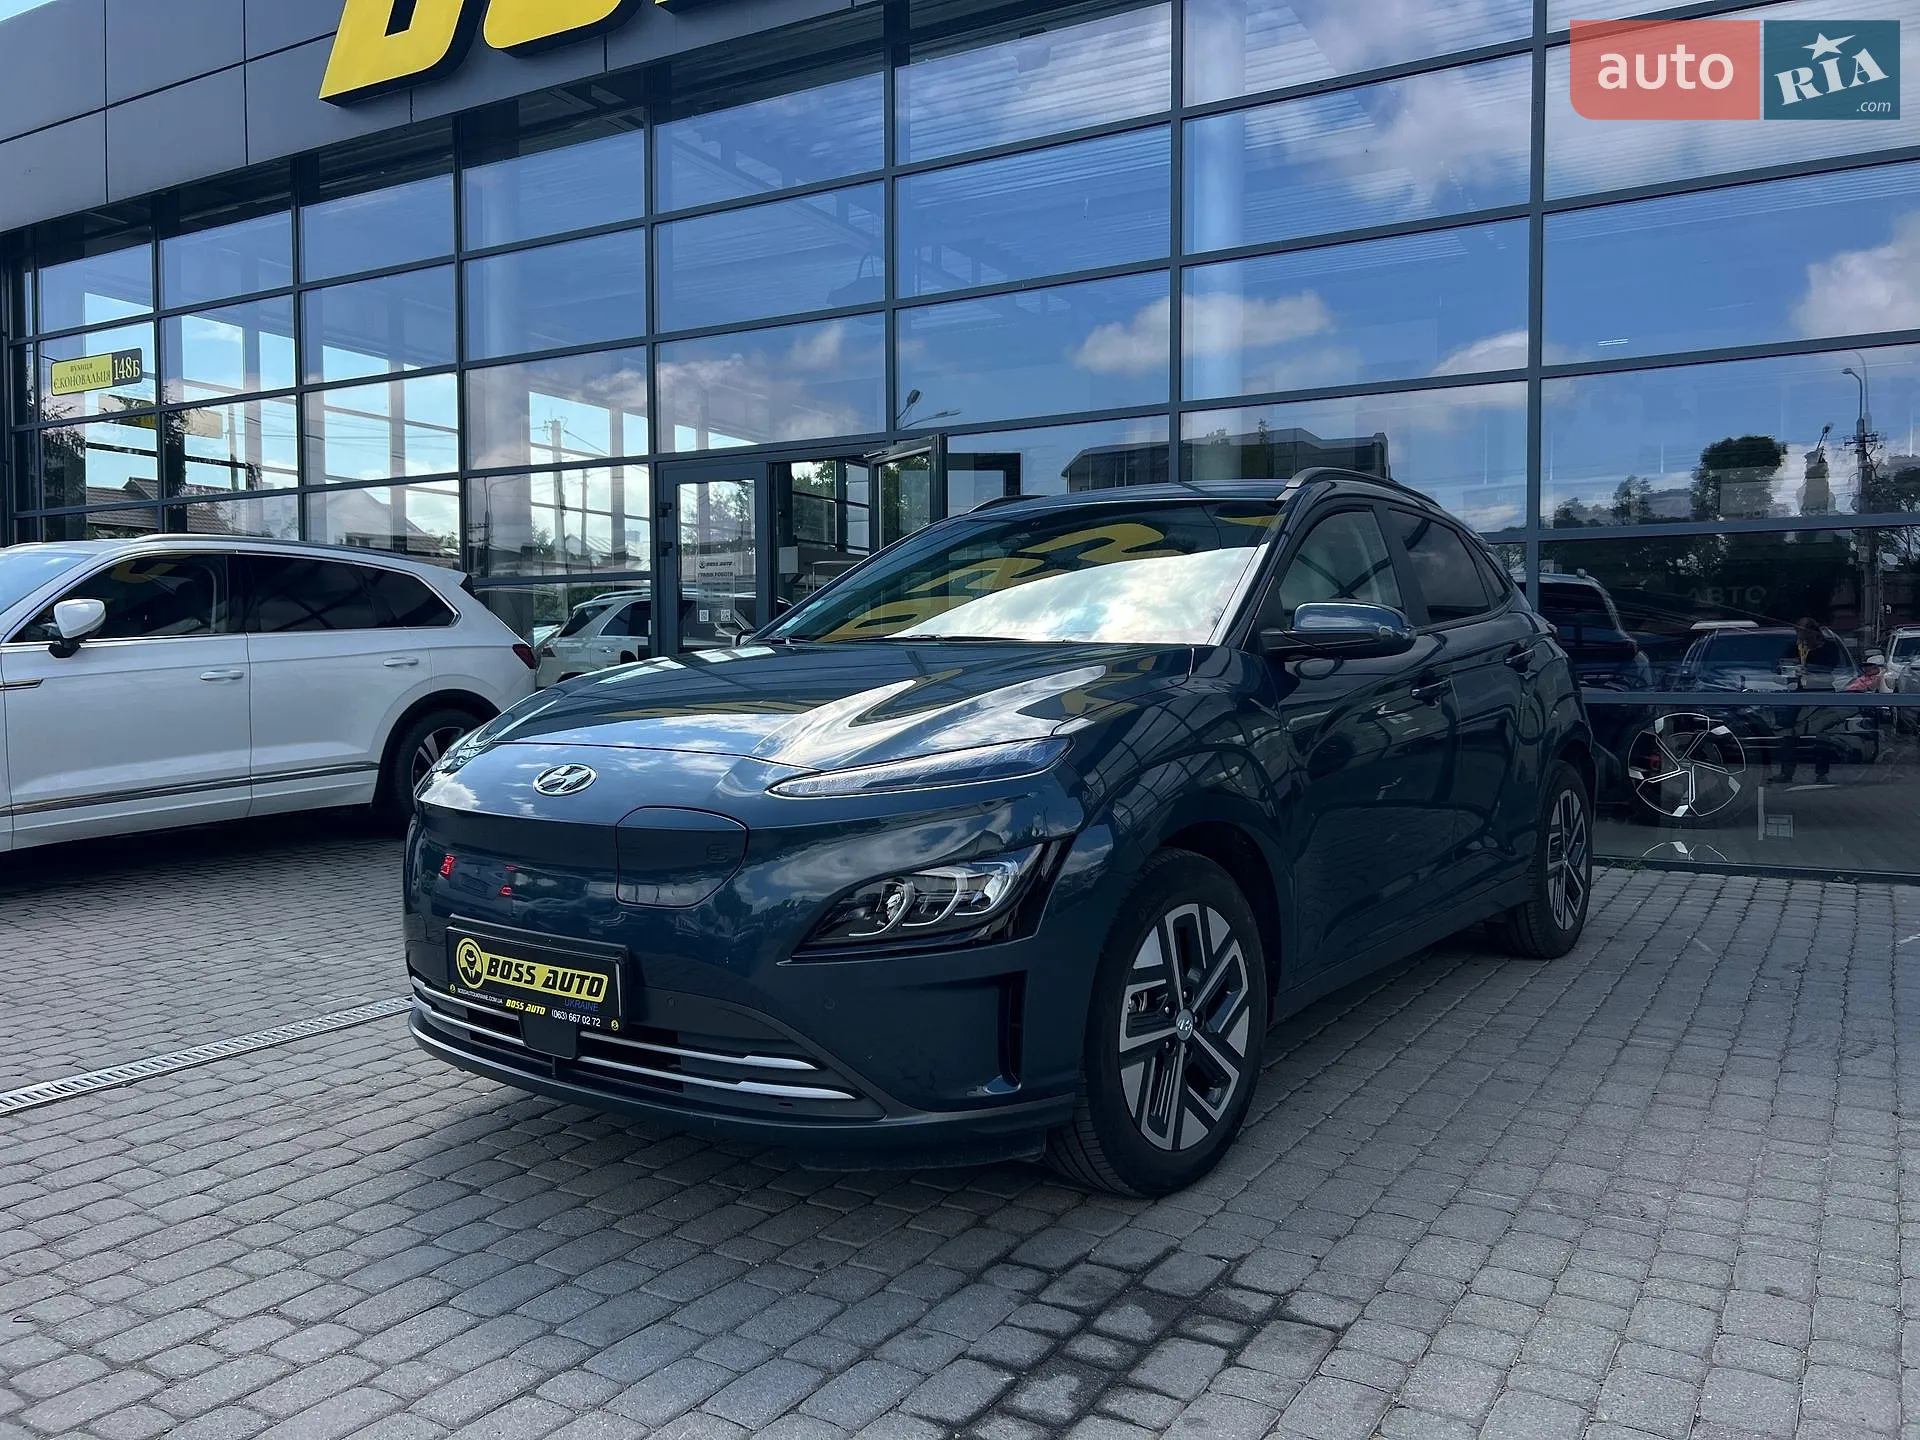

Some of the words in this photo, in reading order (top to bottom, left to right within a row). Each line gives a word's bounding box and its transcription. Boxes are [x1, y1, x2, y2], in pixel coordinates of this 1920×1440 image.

[113, 356, 141, 380] 148Б
[486, 958, 536, 985] BOSS
[542, 969, 604, 996] AUTO
[506, 999, 525, 1011] BOSS
[525, 1004, 546, 1015] AUTO
[564, 999, 599, 1012] UKRAINE
[551, 1009, 567, 1020] (063)
[569, 1012, 581, 1023] 667
[582, 1016, 591, 1025] 02
[592, 1017, 601, 1027] 72
